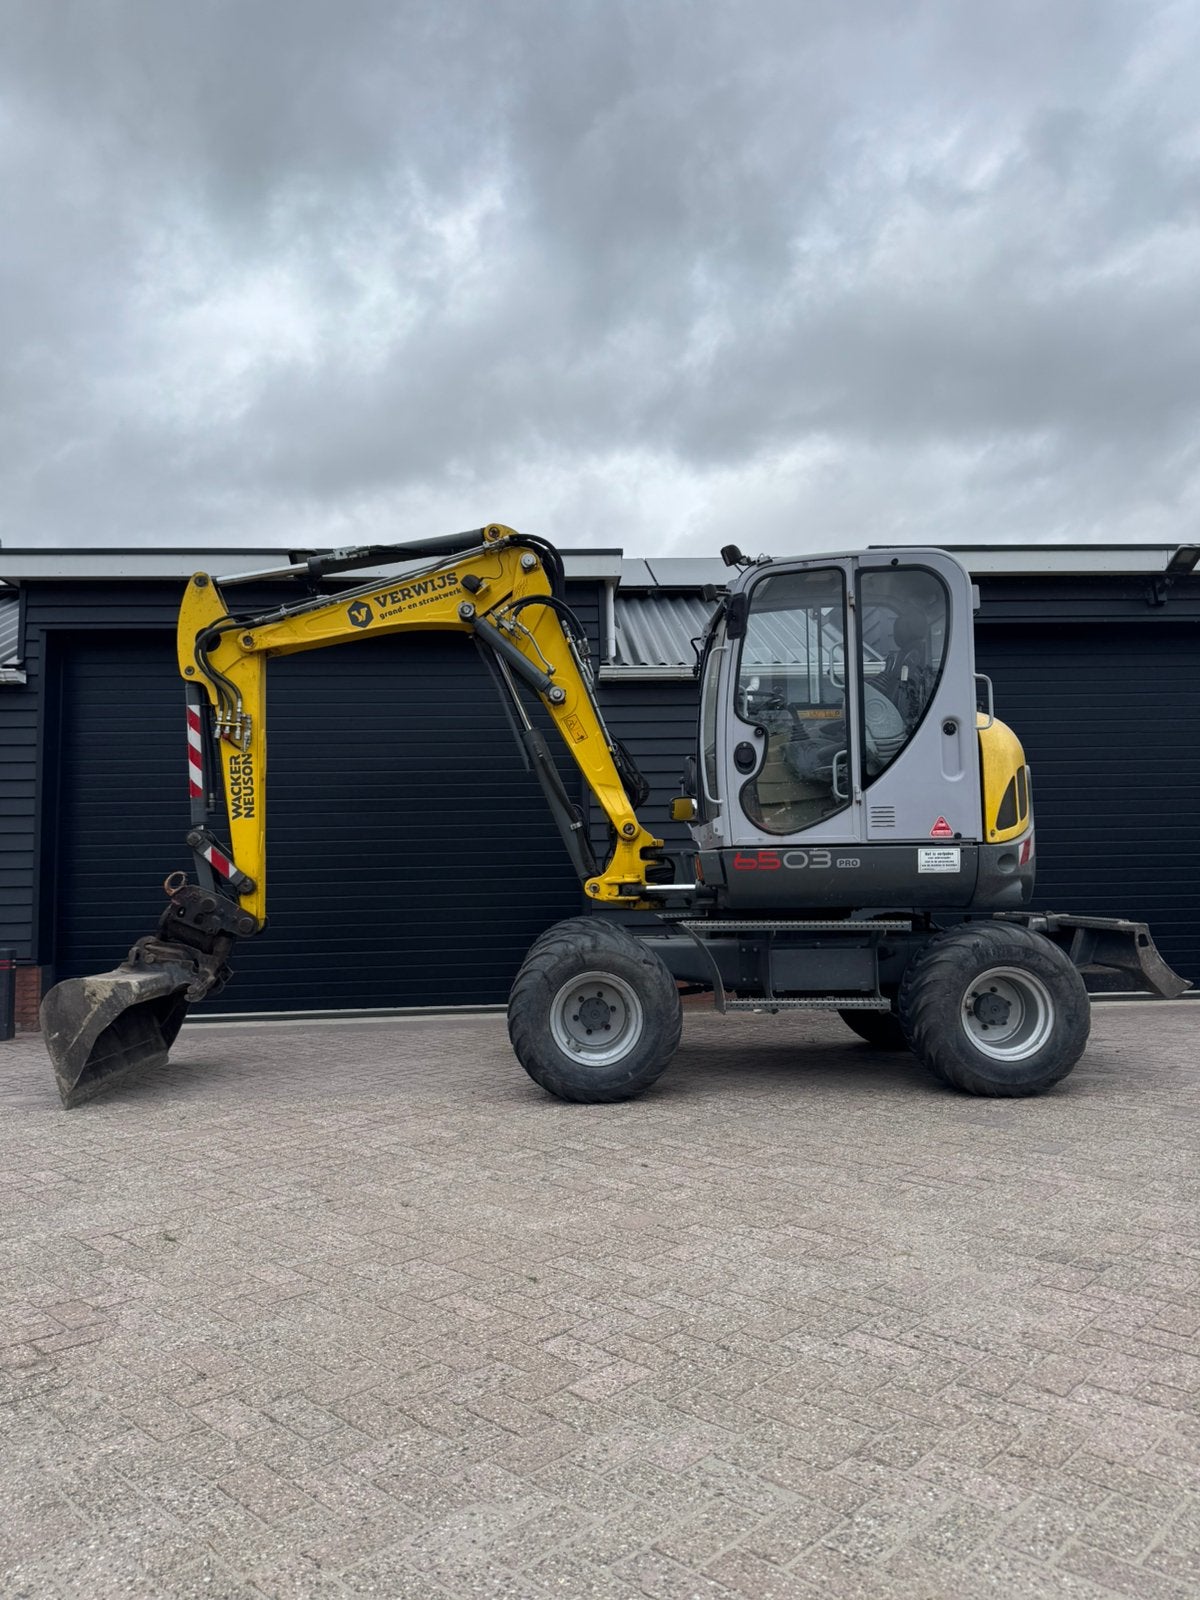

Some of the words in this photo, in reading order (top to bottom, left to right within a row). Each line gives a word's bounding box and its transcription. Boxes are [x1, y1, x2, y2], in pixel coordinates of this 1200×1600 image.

[374, 572, 459, 609] VERWIJS
[379, 606, 407, 620] grond-
[407, 601, 418, 610] en
[419, 586, 462, 606] straatwerk
[229, 754, 243, 820] WACKER
[242, 753, 255, 818] NEUSON
[733, 851, 831, 870] 6503
[838, 859, 859, 868] PRO
